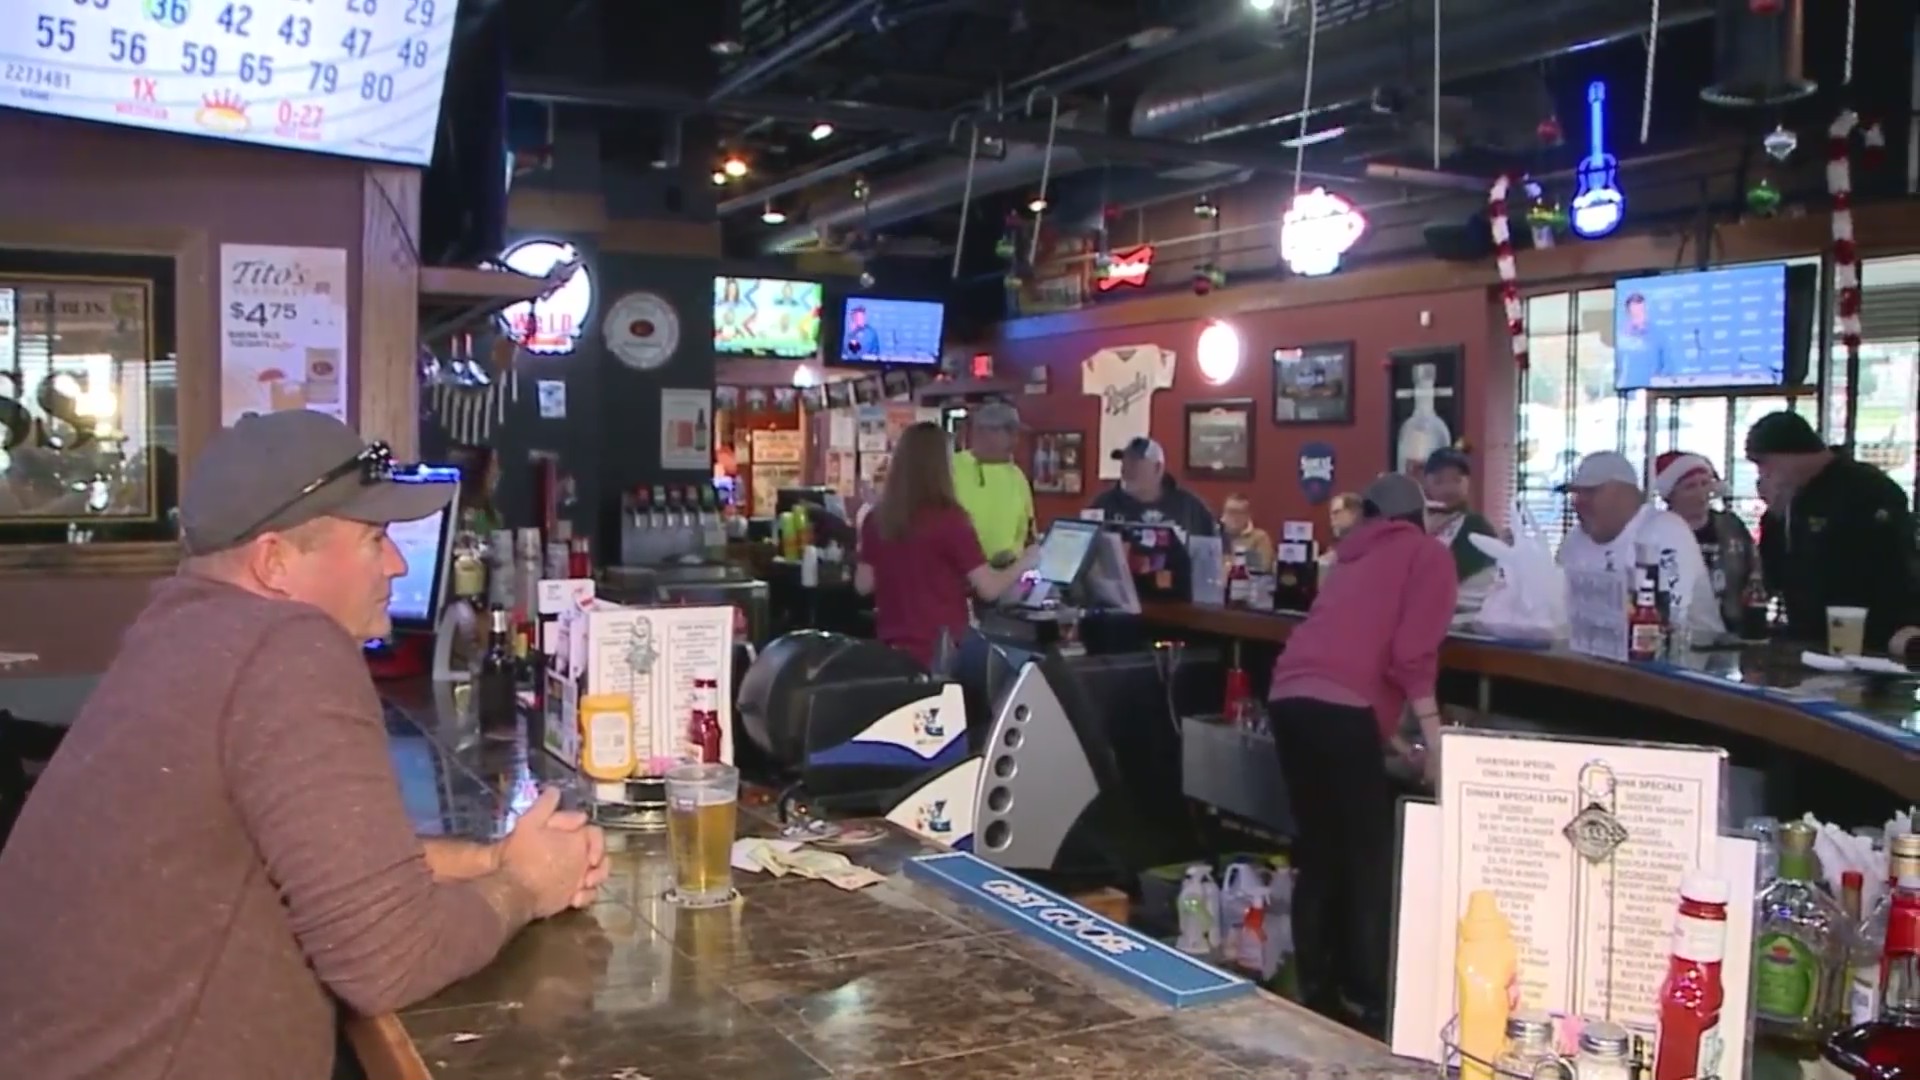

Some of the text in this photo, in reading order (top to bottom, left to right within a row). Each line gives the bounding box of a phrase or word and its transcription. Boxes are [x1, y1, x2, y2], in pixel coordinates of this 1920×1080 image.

[151, 0, 428, 68] 36 42 43 47 48
[403, 0, 436, 27] 29
[37, 15, 394, 102] 55 56 59 65 79 80
[278, 99, 324, 129] 0:27
[1466, 788, 1500, 799] DINNER
[1503, 791, 1544, 803] SPECIALS
[981, 879, 1148, 955] GREY GOOSE
